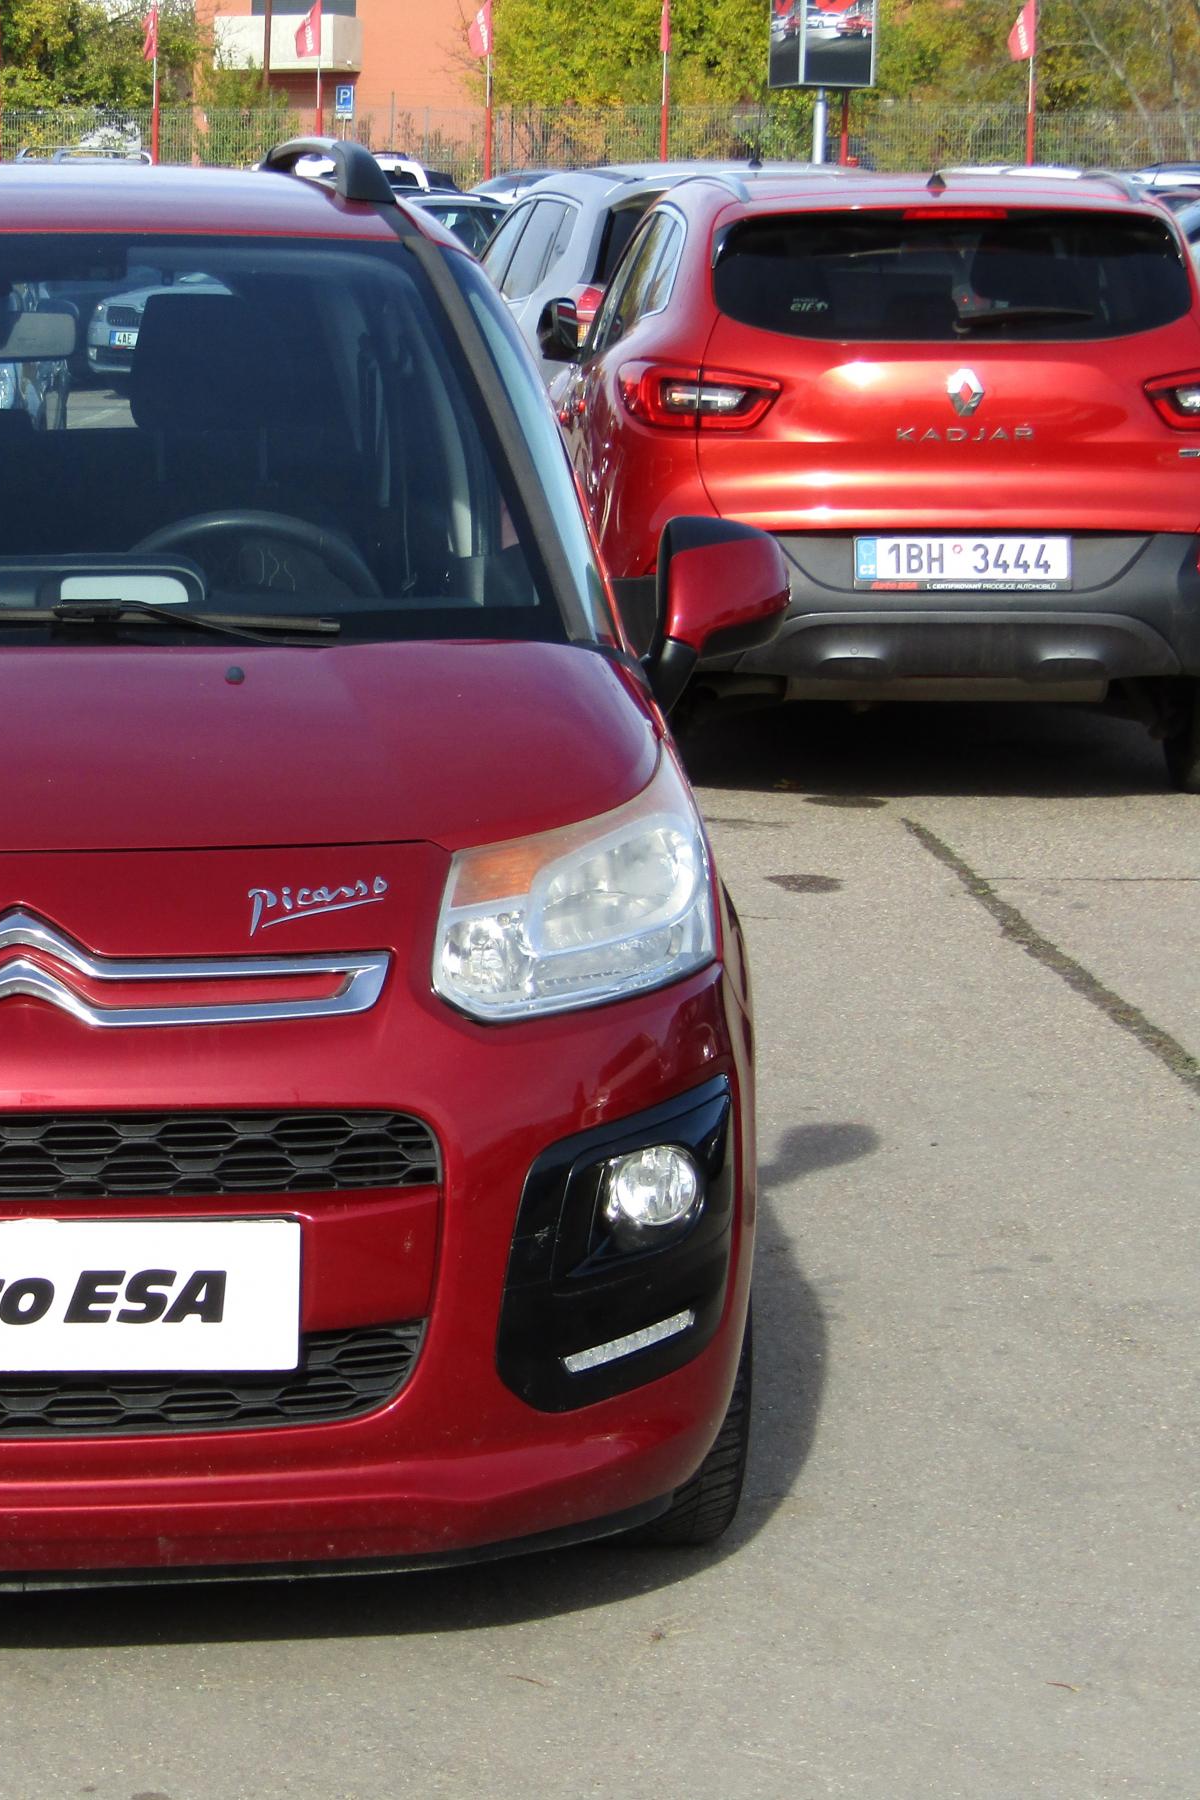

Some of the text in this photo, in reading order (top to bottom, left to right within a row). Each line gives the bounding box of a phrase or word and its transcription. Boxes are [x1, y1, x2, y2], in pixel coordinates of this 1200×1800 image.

[340, 89, 350, 104] P
[896, 426, 1034, 441] KADJAR
[860, 564, 876, 575] CZ
[888, 544, 1051, 574] 1BH 3444
[248, 876, 388, 936] Picasso
[62, 1268, 228, 1324] ESA
